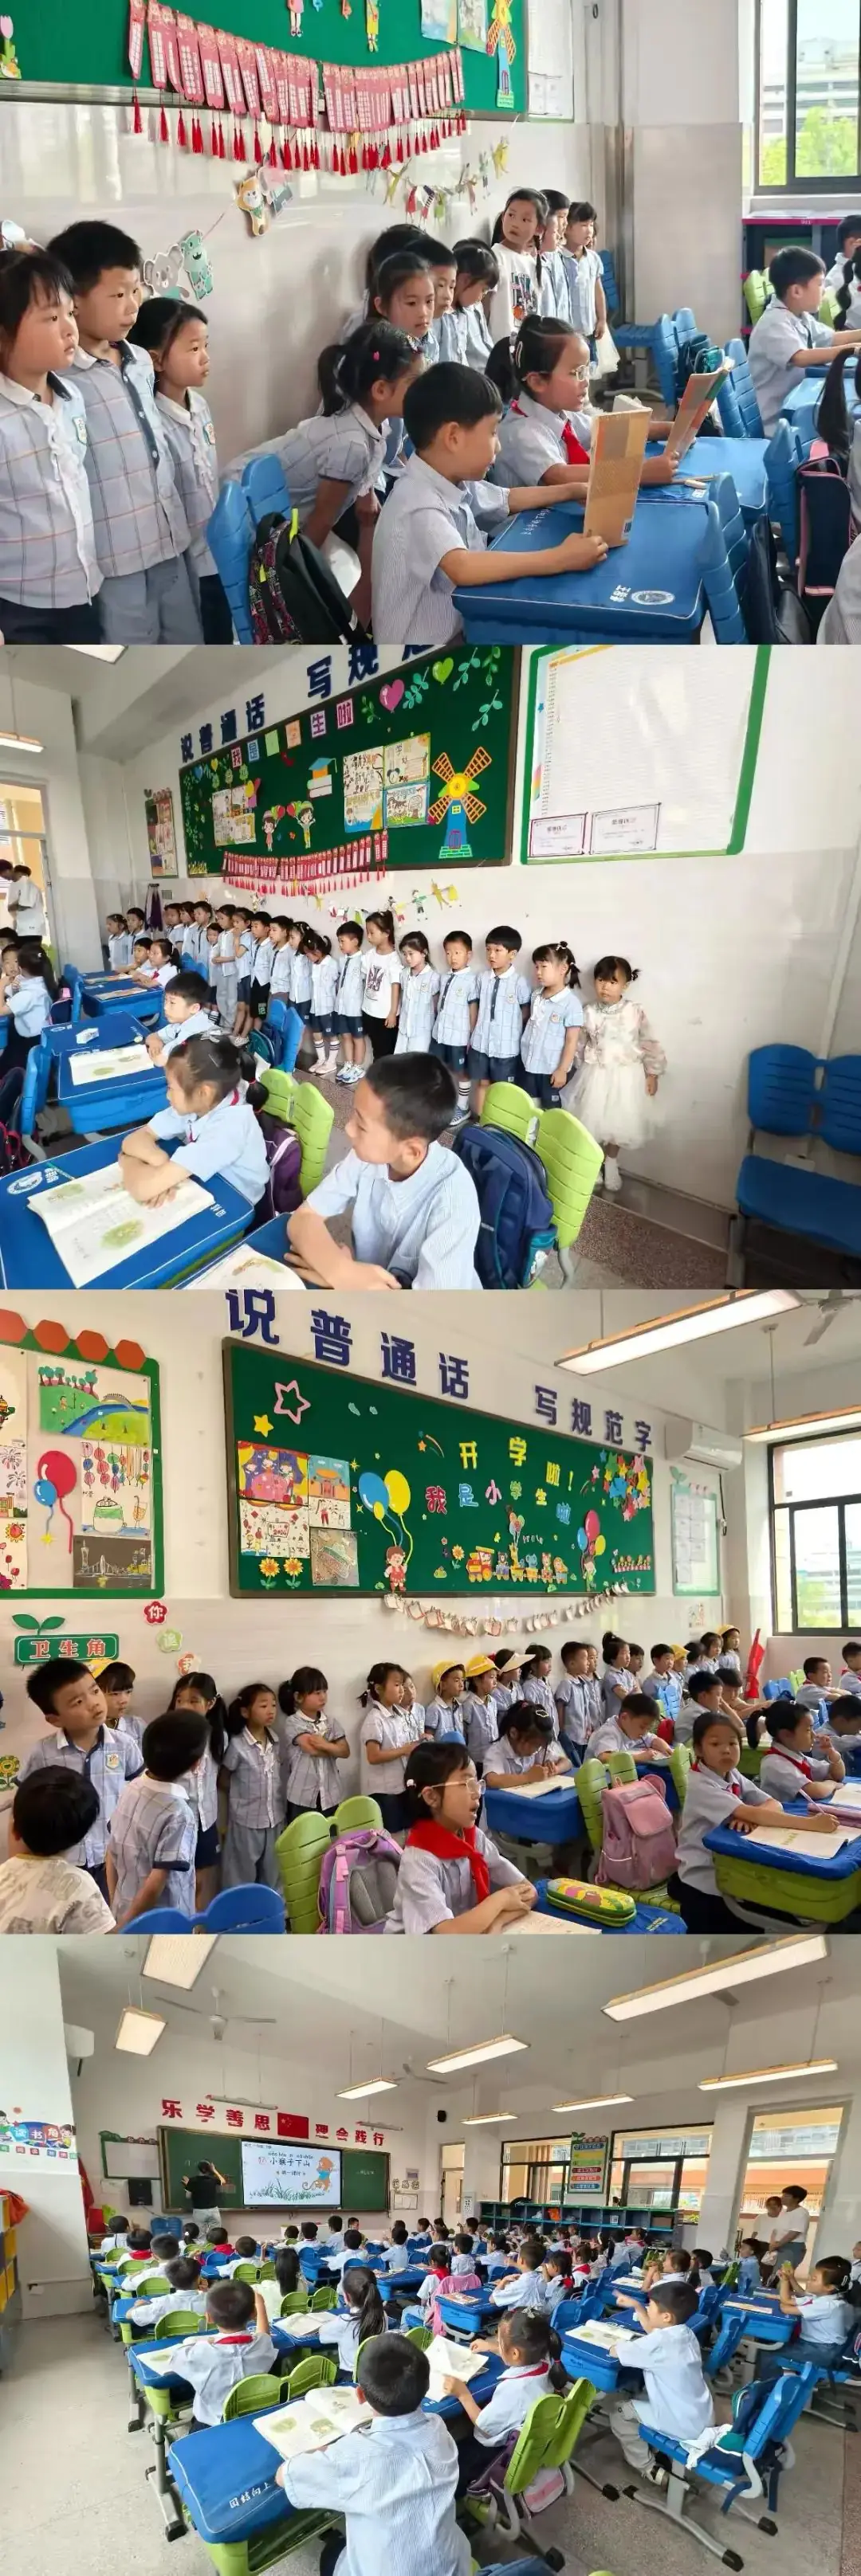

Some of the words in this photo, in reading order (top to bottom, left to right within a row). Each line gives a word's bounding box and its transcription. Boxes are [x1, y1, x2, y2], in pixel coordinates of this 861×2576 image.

[225, 1289, 469, 1399] 说普通话
[535, 1385, 651, 1452] 写规范字
[425, 1479, 572, 1525] 我是小学生啦
[29, 1638, 106, 1660] 卫生角
[162, 2099, 270, 2131] 乐学善思
